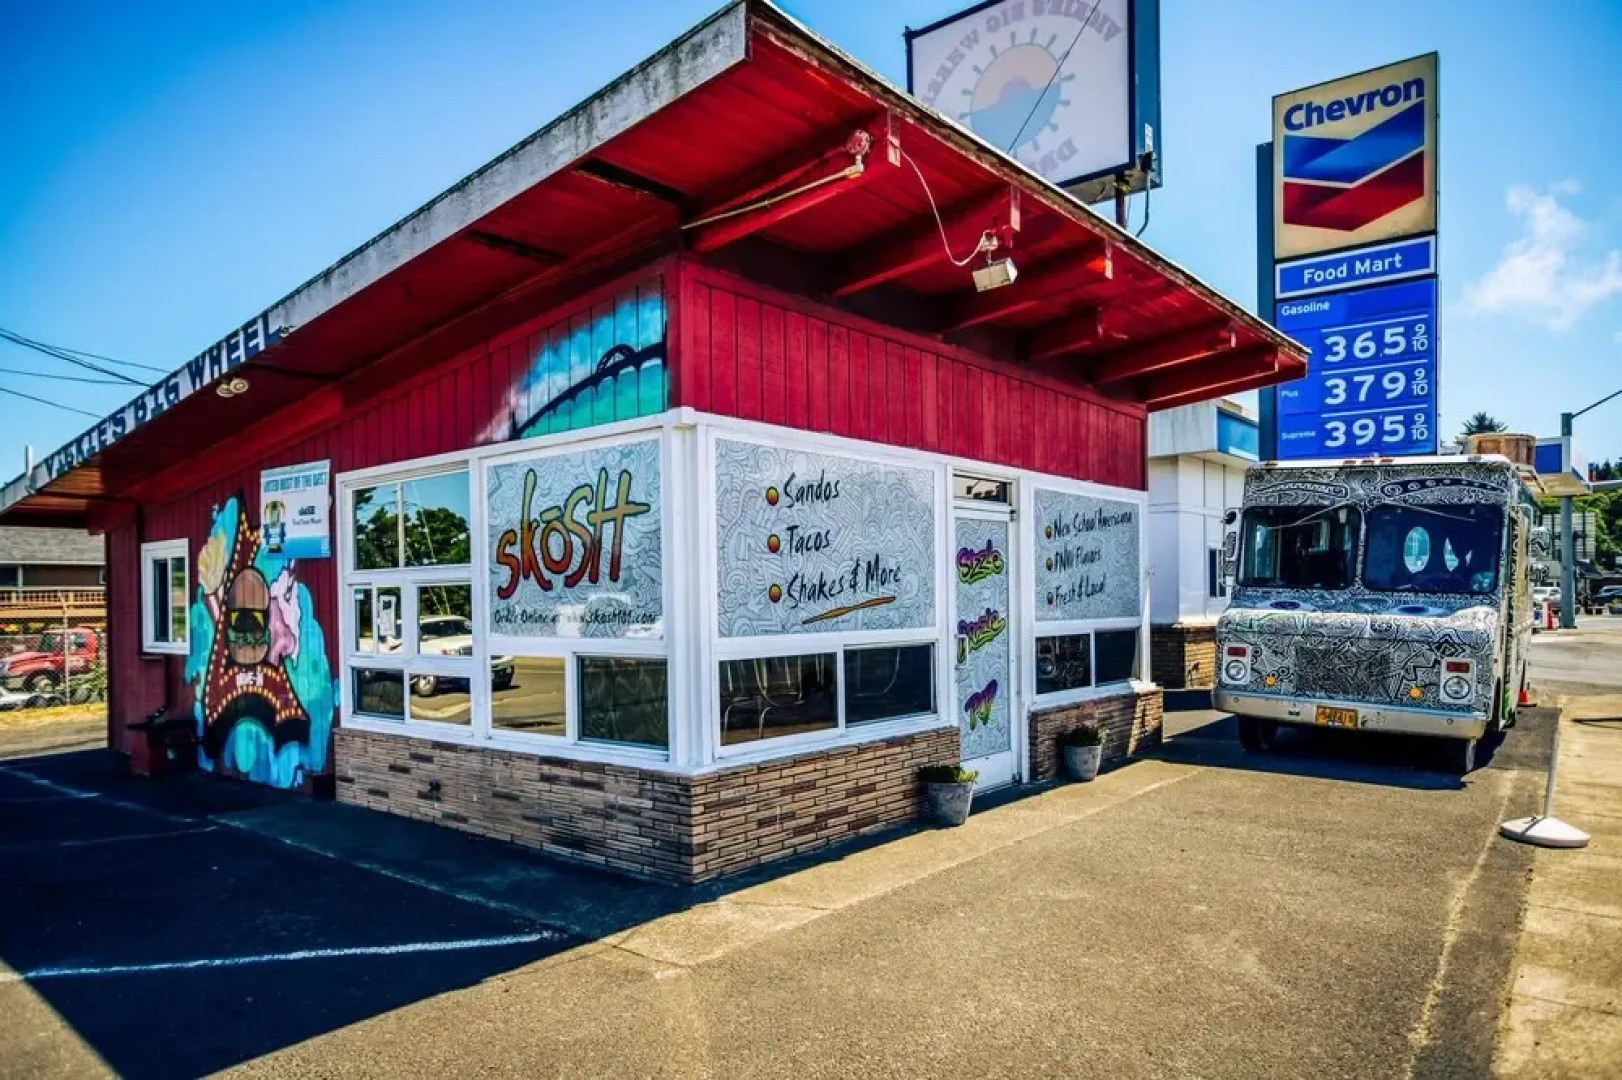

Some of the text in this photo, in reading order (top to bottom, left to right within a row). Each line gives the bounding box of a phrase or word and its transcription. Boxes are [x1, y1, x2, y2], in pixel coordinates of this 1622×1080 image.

[1283, 77, 1425, 131] Chevron
[1303, 253, 1402, 284] Food Mart
[1281, 301, 1330, 316] Gasoline
[1324, 326, 1406, 363] 365
[132, 371, 181, 424] BIG
[184, 311, 284, 393] WHEEL
[1324, 371, 1406, 405] 379
[1324, 415, 1406, 448] 395
[783, 469, 841, 508] Sandos
[785, 525, 830, 557] Tacos
[787, 572, 844, 608] Shakes
[866, 553, 900, 592] More
